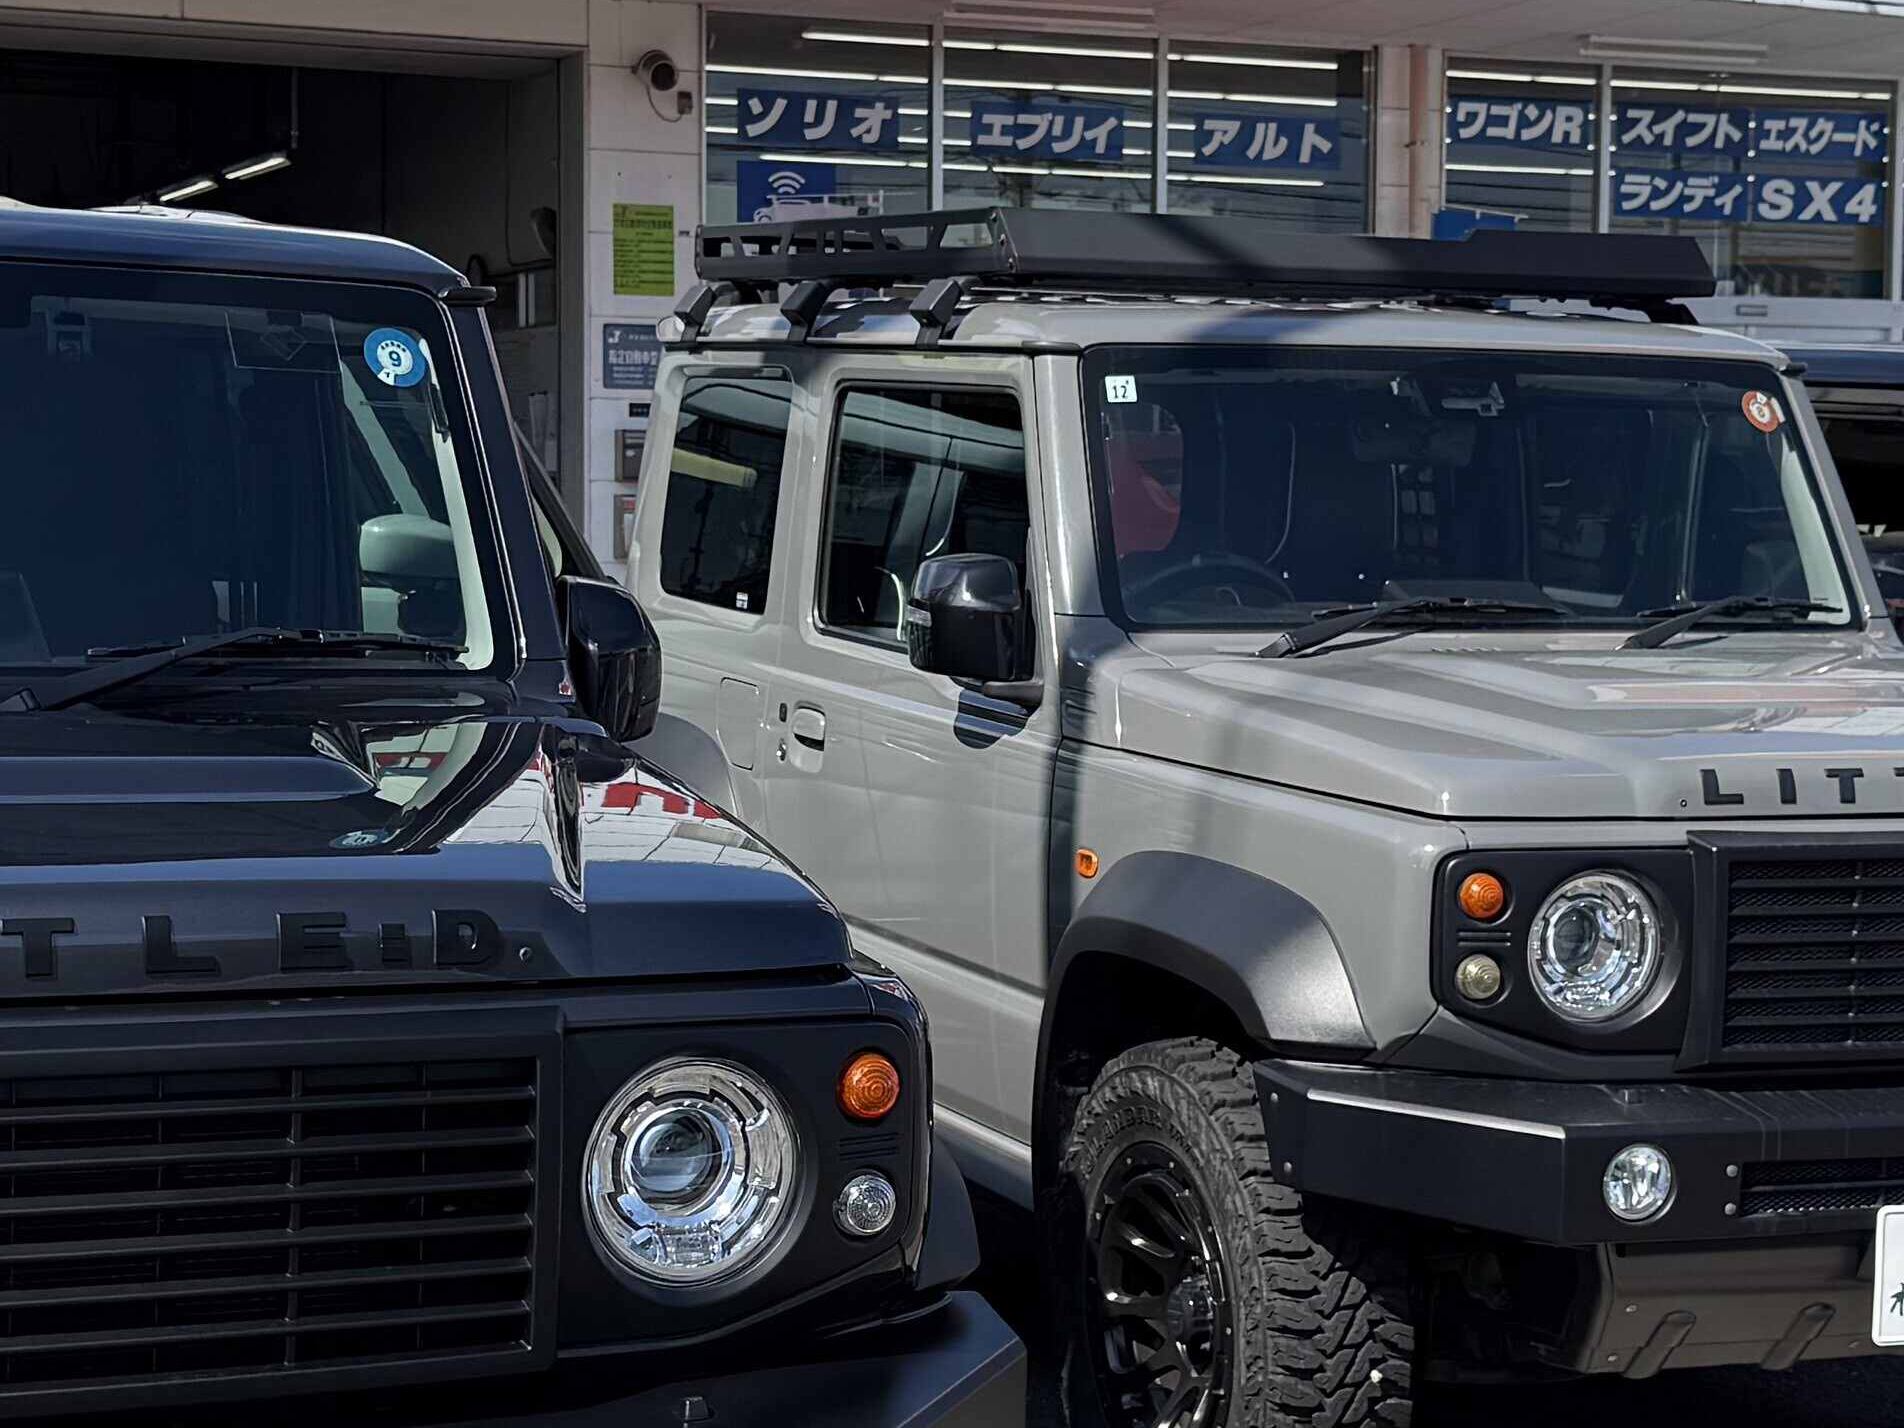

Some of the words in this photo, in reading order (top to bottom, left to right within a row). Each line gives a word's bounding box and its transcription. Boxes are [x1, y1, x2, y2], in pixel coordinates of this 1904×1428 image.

[744, 95, 894, 144] ソリオ
[1199, 119, 1334, 164] アルト
[1455, 101, 1584, 146] ワゴンR
[1621, 107, 1744, 151] スイフト
[1758, 117, 1881, 158] エスクード
[1618, 173, 1744, 218] ランディ
